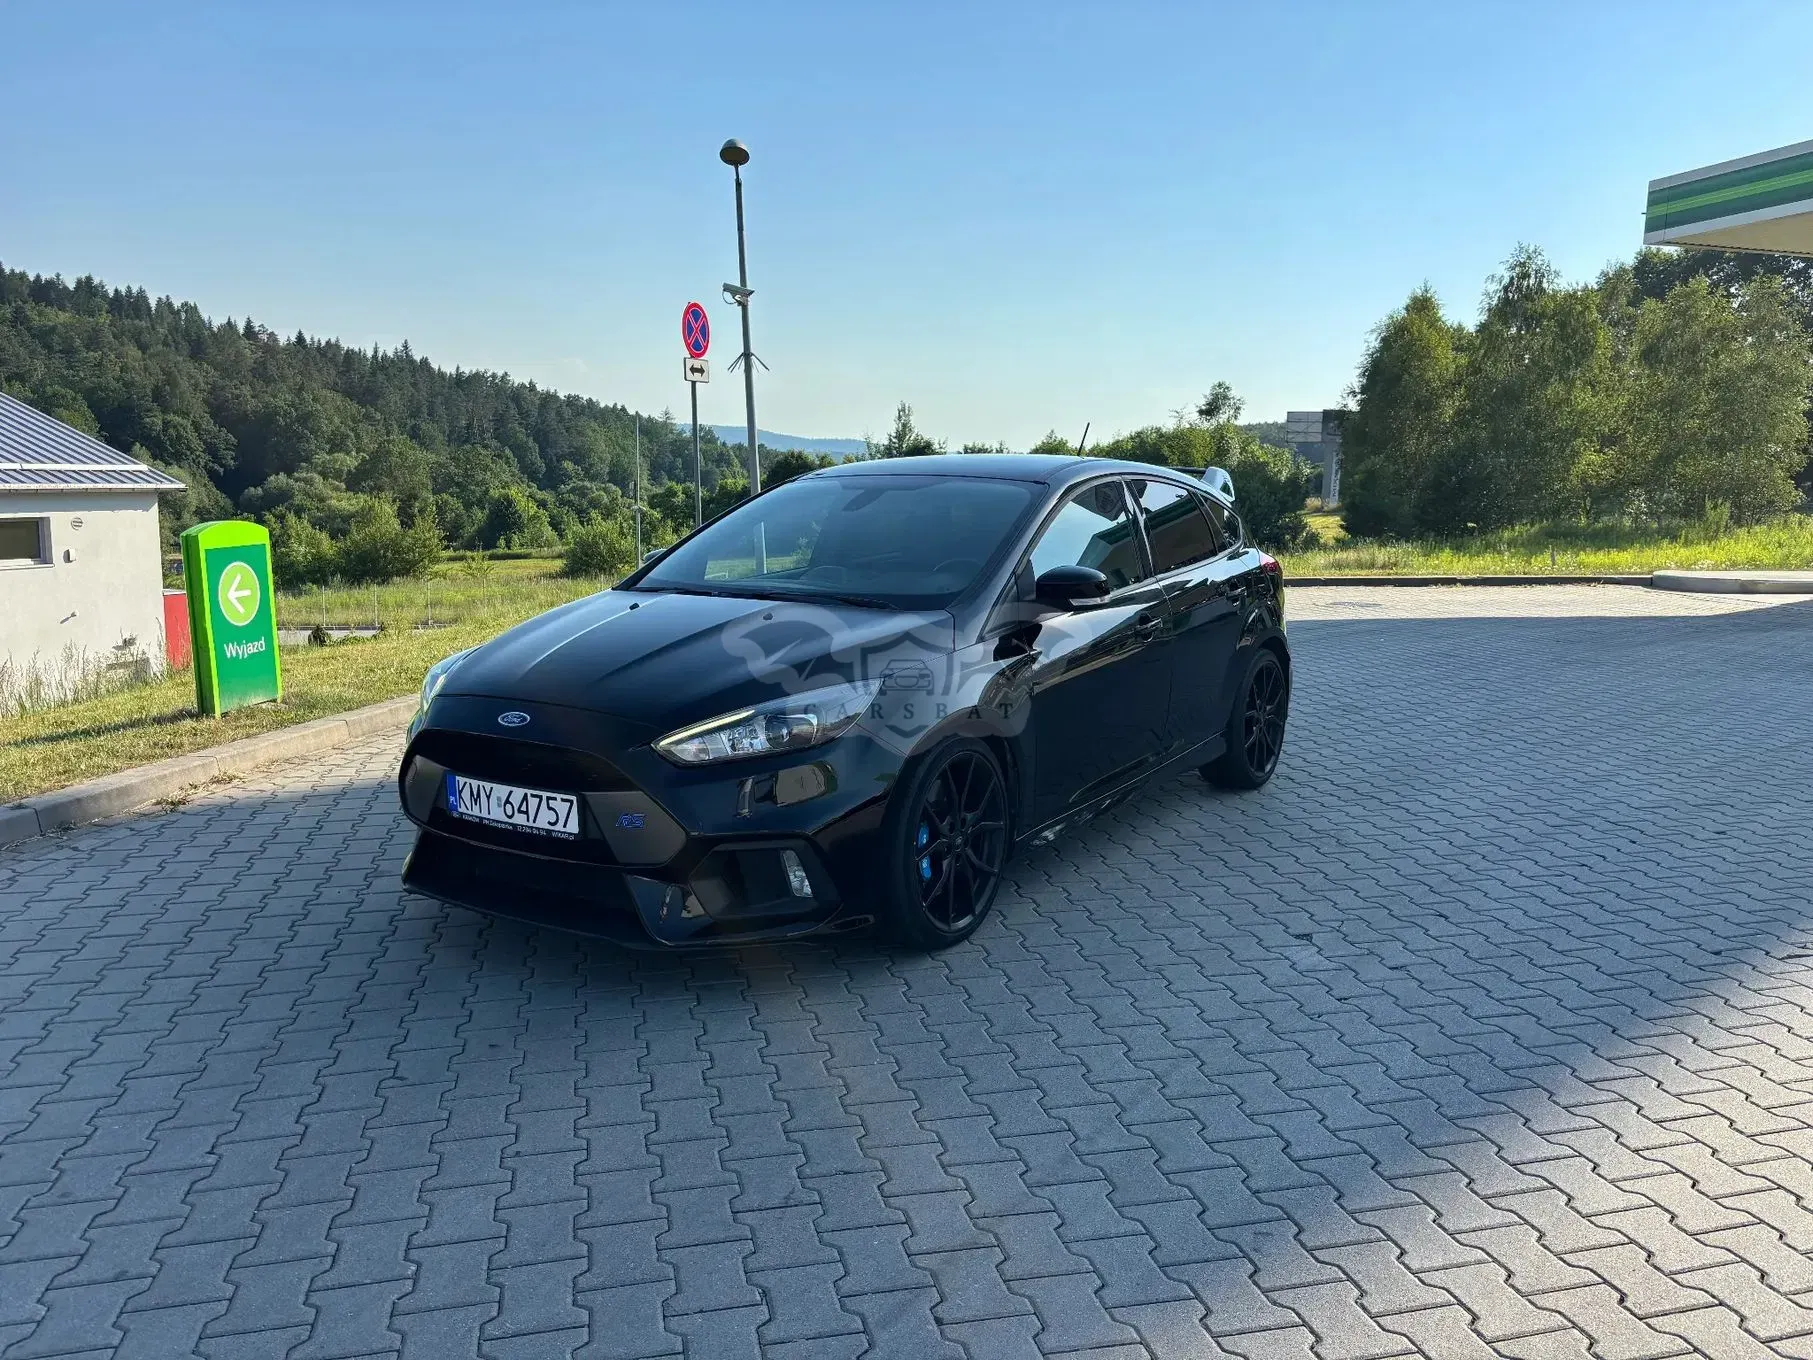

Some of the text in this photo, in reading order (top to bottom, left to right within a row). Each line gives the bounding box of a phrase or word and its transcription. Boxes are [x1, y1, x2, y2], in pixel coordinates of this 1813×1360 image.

[223, 636, 266, 659] Wyjazd
[457, 780, 575, 829] KMY 64757
[615, 813, 645, 828] RS
